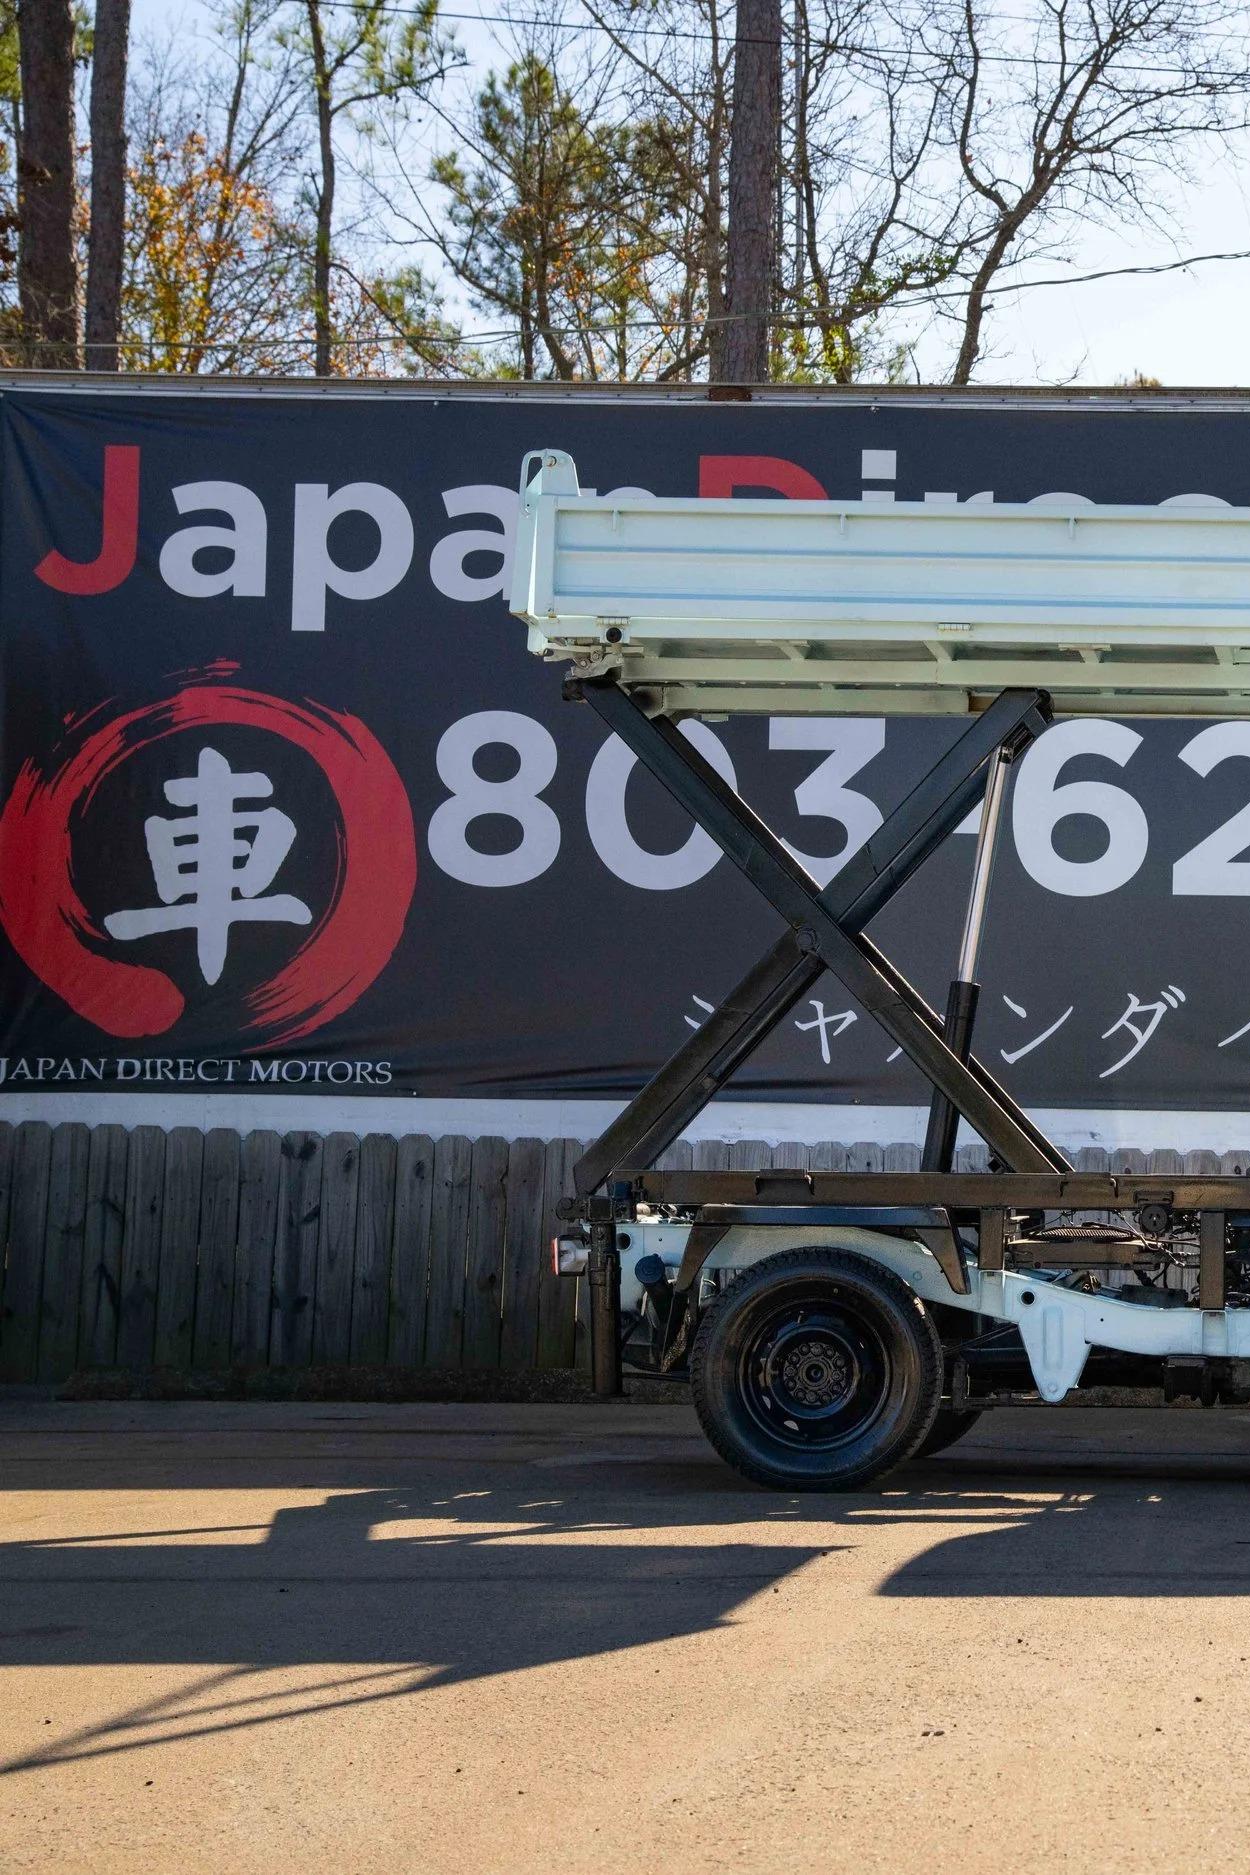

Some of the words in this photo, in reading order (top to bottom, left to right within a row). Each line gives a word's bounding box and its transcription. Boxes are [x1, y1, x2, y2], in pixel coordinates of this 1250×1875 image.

[104, 747, 312, 986] 車
[0, 1057, 107, 1085] JAPAN
[116, 1058, 240, 1083] DIRECT
[248, 1060, 392, 1085] MOTORS
